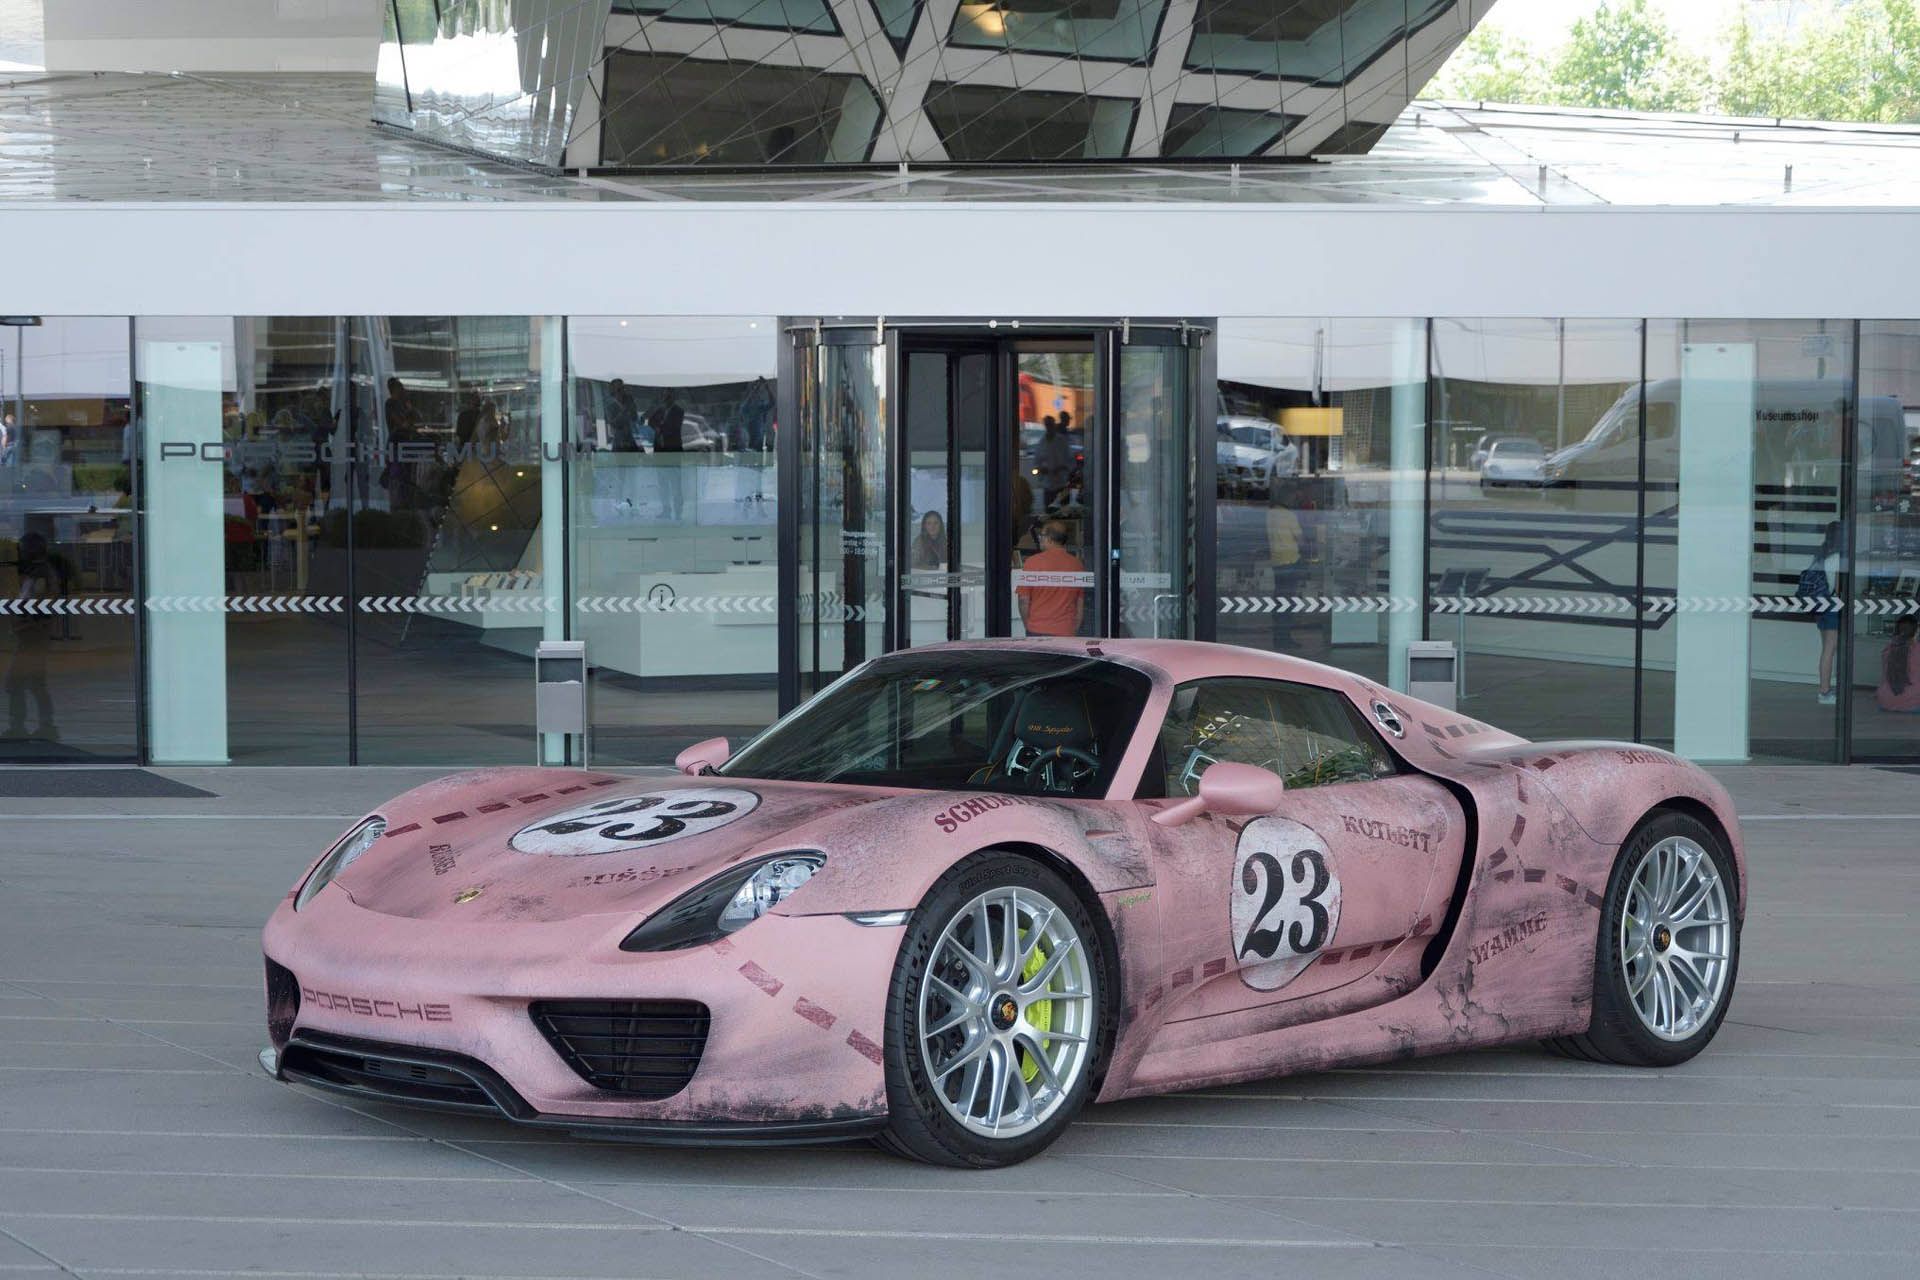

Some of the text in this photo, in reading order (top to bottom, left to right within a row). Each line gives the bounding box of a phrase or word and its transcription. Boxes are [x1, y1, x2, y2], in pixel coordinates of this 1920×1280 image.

[160, 442, 437, 461] PORSCHE
[1017, 574, 1095, 583] PORSCHE
[522, 796, 738, 841] 23
[1238, 849, 1331, 960] 23
[1472, 911, 1547, 965] WAMME
[303, 987, 453, 1022] PORSCHE
